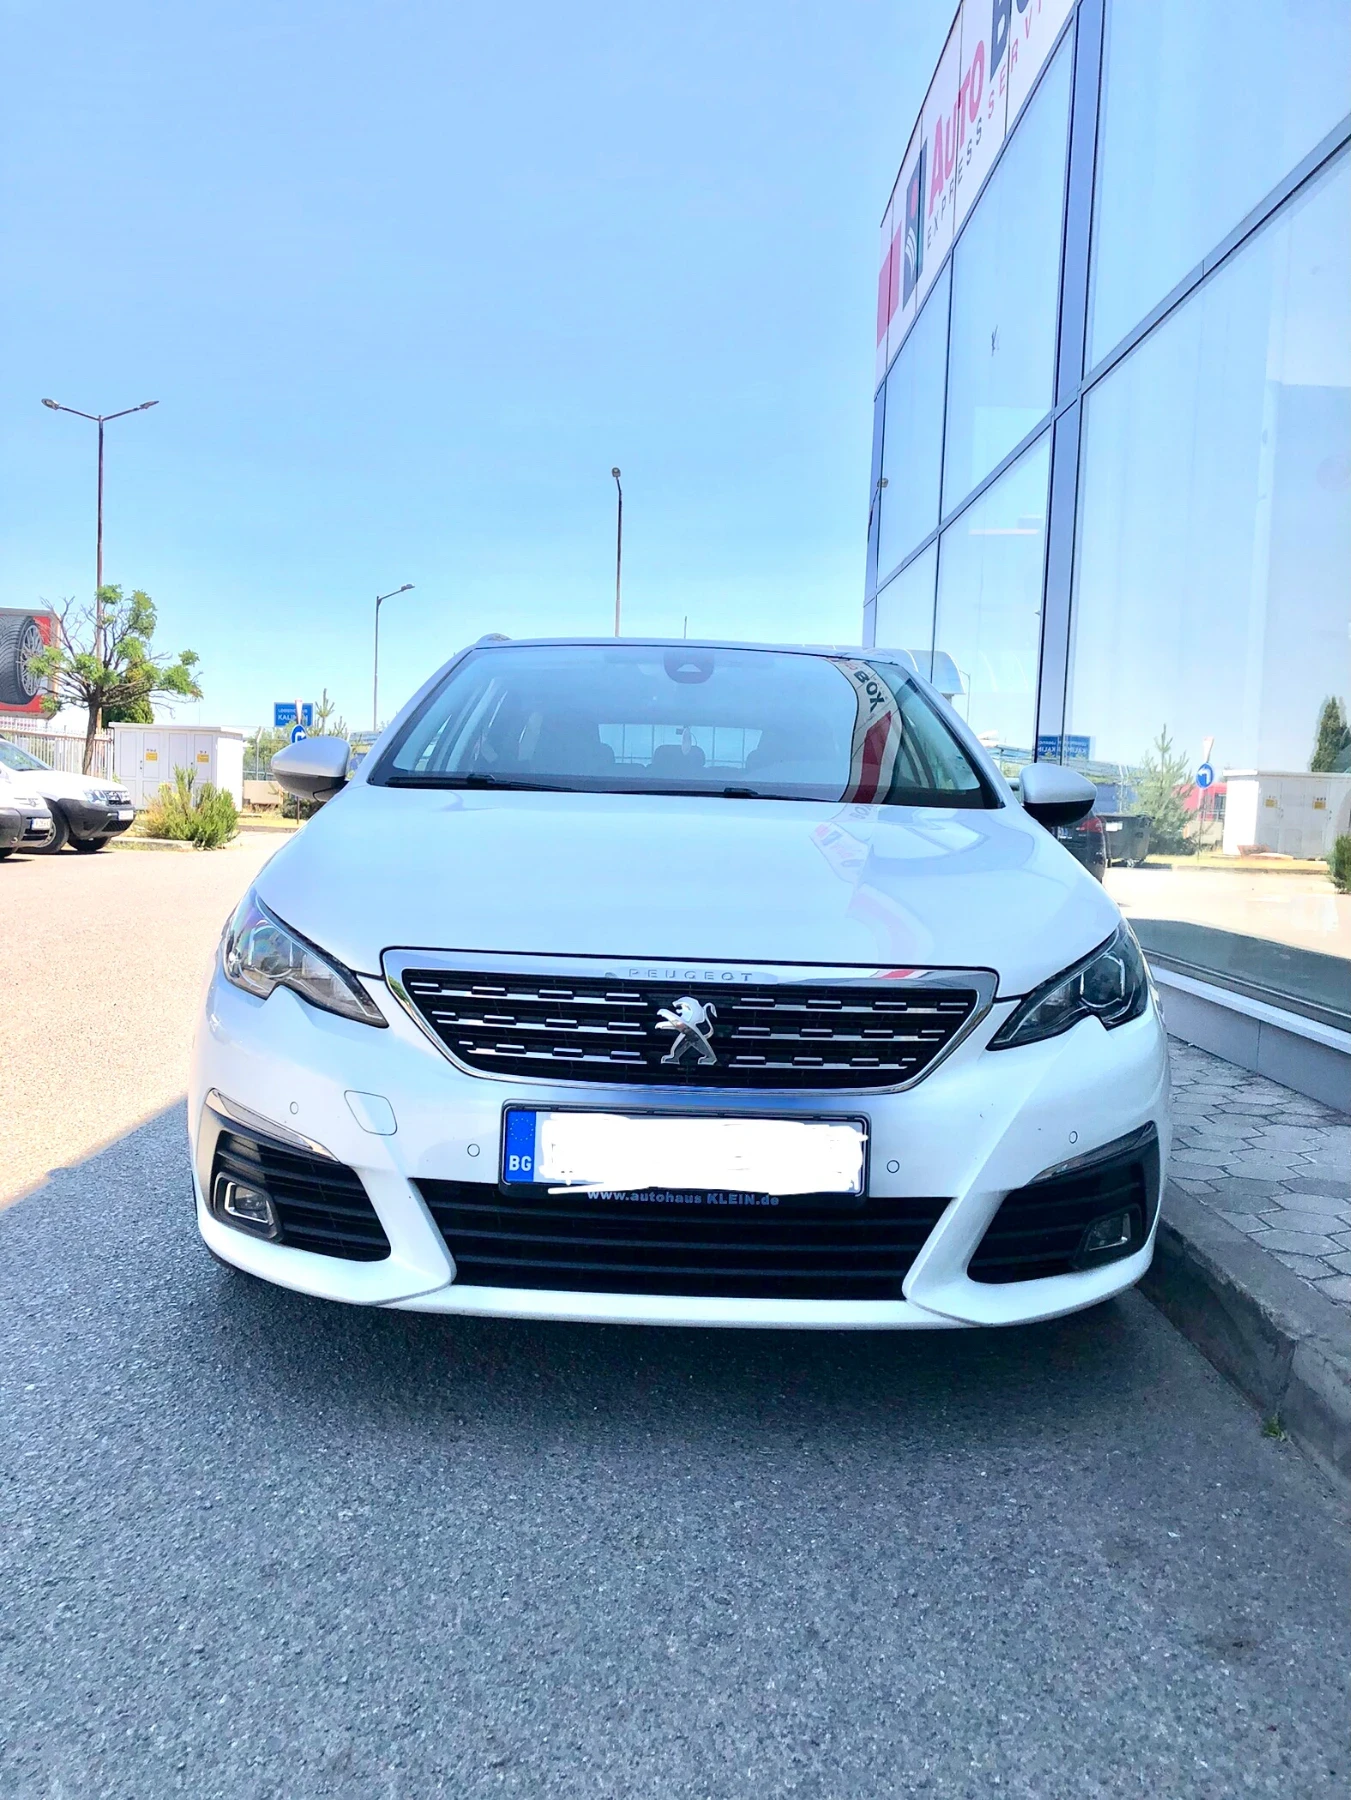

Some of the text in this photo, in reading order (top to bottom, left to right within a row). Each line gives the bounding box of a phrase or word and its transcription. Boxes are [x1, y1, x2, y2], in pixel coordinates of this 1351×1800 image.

[928, 40, 985, 220] AUTO
[927, 117, 982, 250] EXPRESS
[628, 968, 753, 982] PEUGEOT
[508, 1154, 532, 1172] BG
[587, 1190, 780, 1206] www.autohaus KLEIN.de
